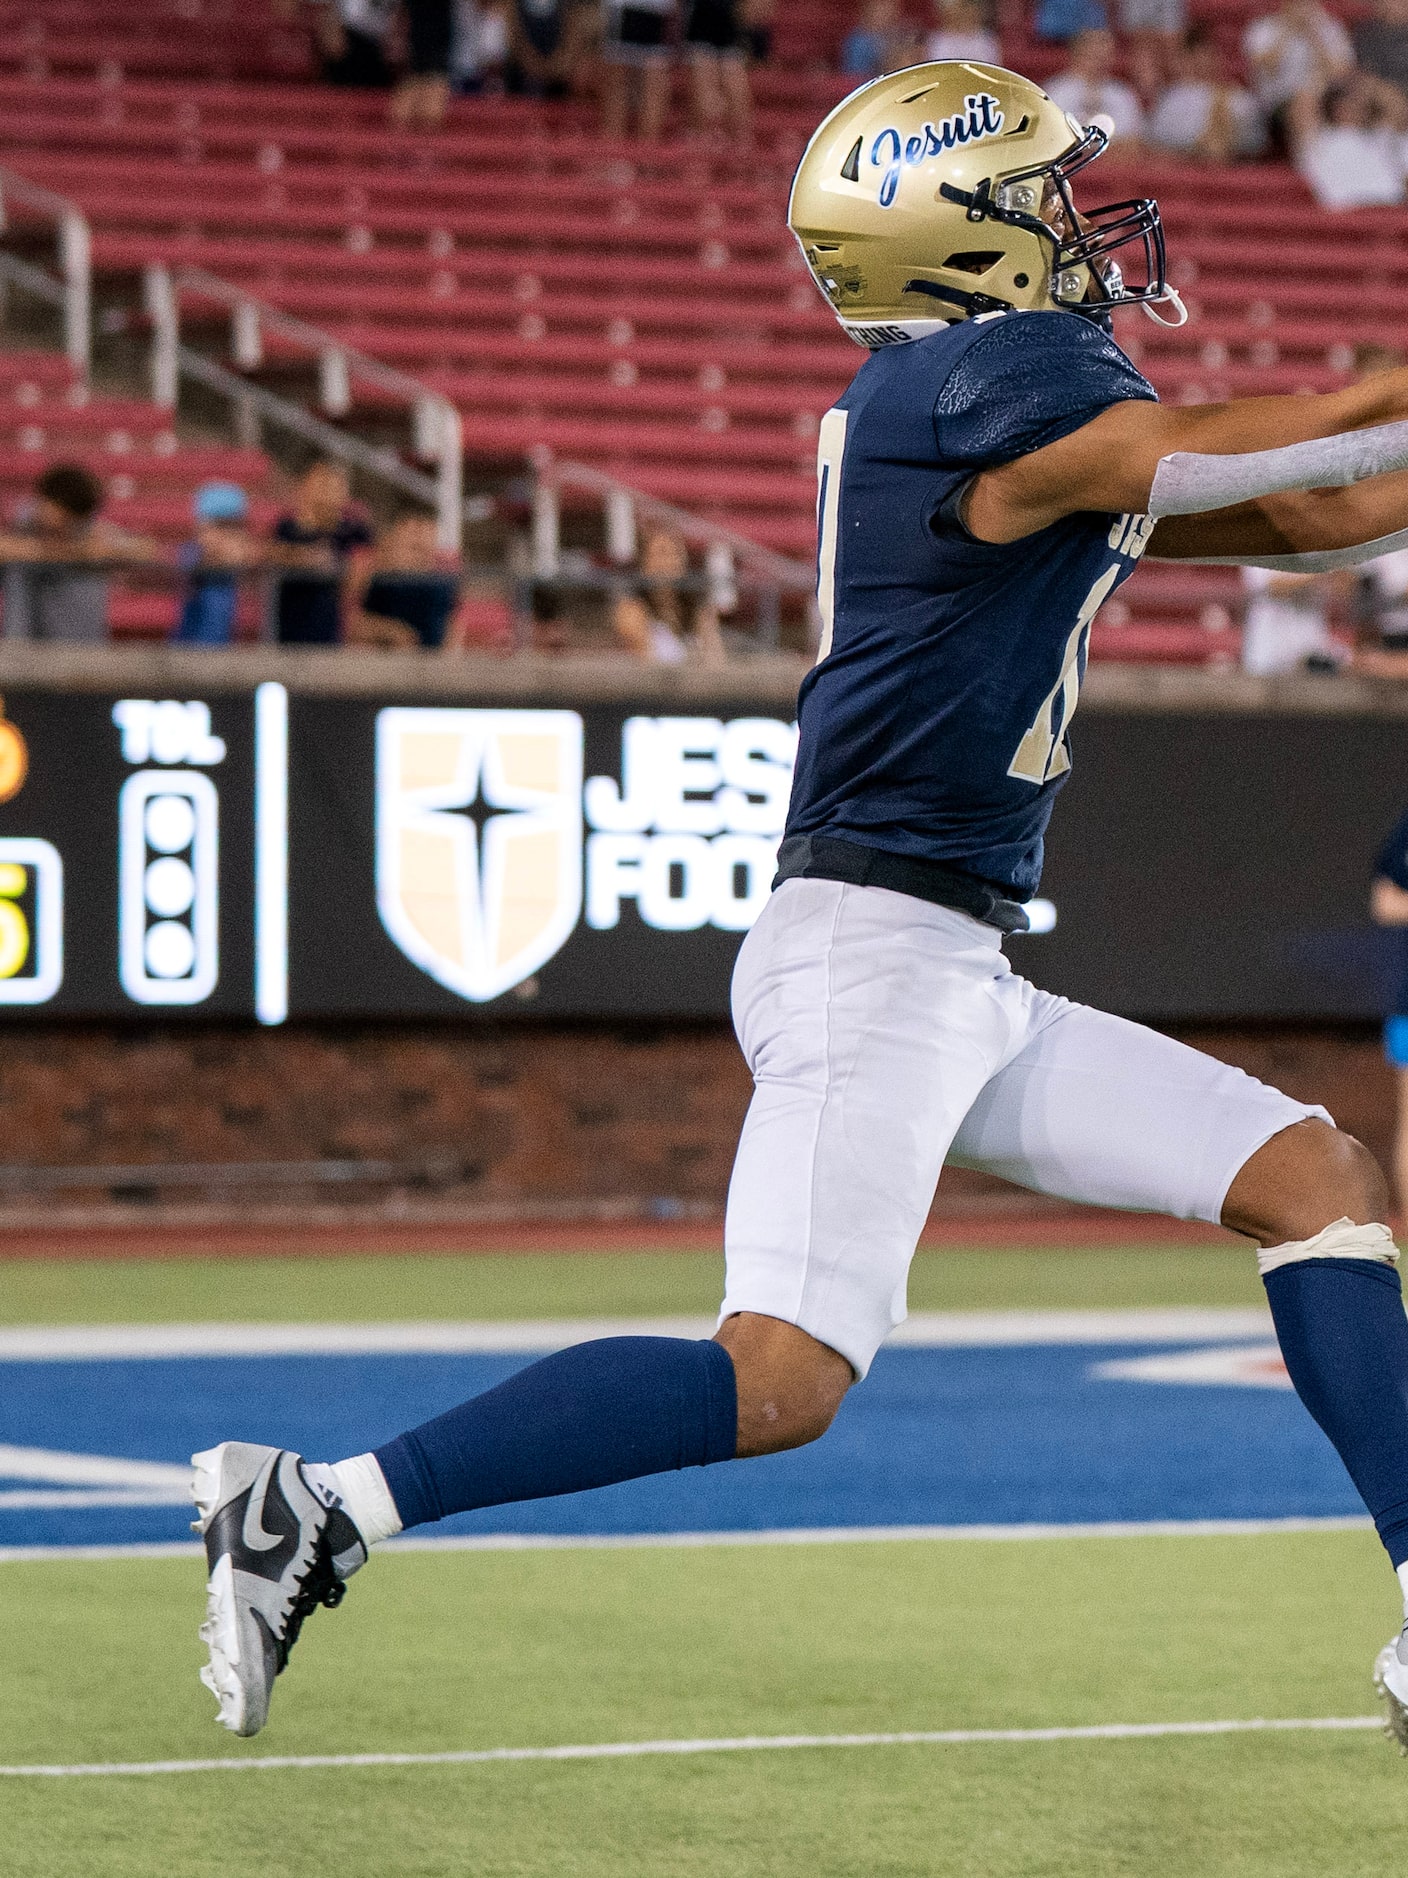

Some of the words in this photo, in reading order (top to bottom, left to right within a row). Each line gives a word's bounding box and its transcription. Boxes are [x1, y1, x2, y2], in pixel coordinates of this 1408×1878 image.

[870, 93, 1003, 208] Jesuit
[583, 716, 800, 834] JES
[584, 832, 779, 931] FOO
